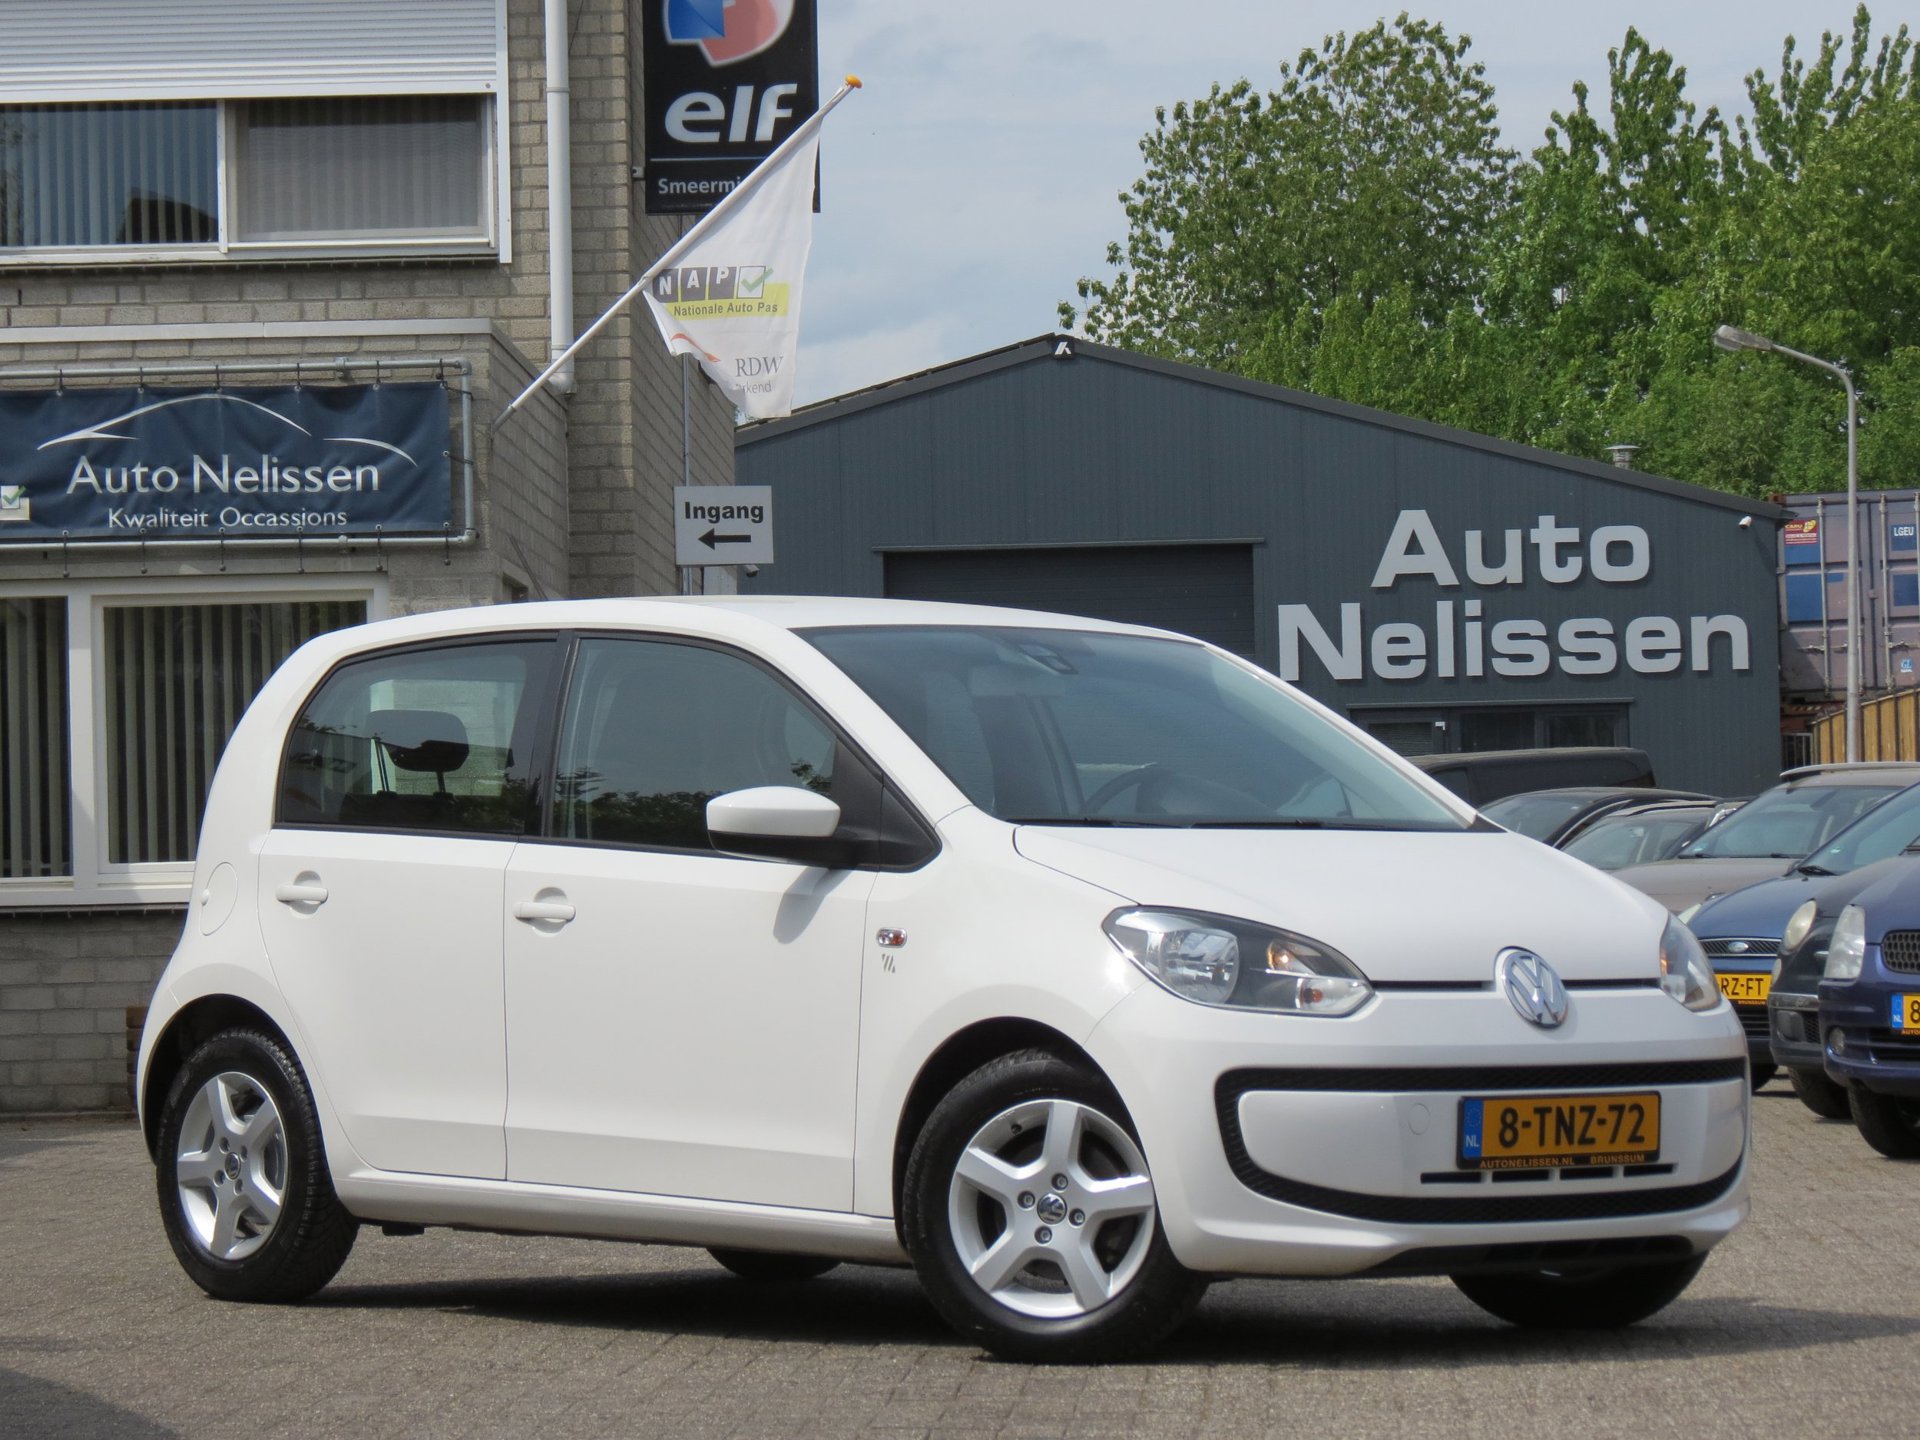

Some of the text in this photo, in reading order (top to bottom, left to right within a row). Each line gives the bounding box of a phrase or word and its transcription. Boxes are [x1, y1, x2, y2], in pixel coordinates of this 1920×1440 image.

[664, 83, 798, 143] elf
[674, 302, 778, 317] Nationale Auto Pas
[735, 356, 784, 377] RDW
[66, 453, 380, 495] Auto Nelissen
[108, 505, 348, 528] Kwaliteit Occassions
[684, 501, 764, 524] Ingang
[1893, 526, 1914, 536] LGEU
[1371, 509, 1650, 588] Auto
[1277, 599, 1751, 682] Nelissen
[1498, 1103, 1645, 1148] 8-TNZ-72
[1465, 1135, 1479, 1148] NL
[1480, 1154, 1645, 1169] AUTONELISSEN.NL BRUNSSUM
